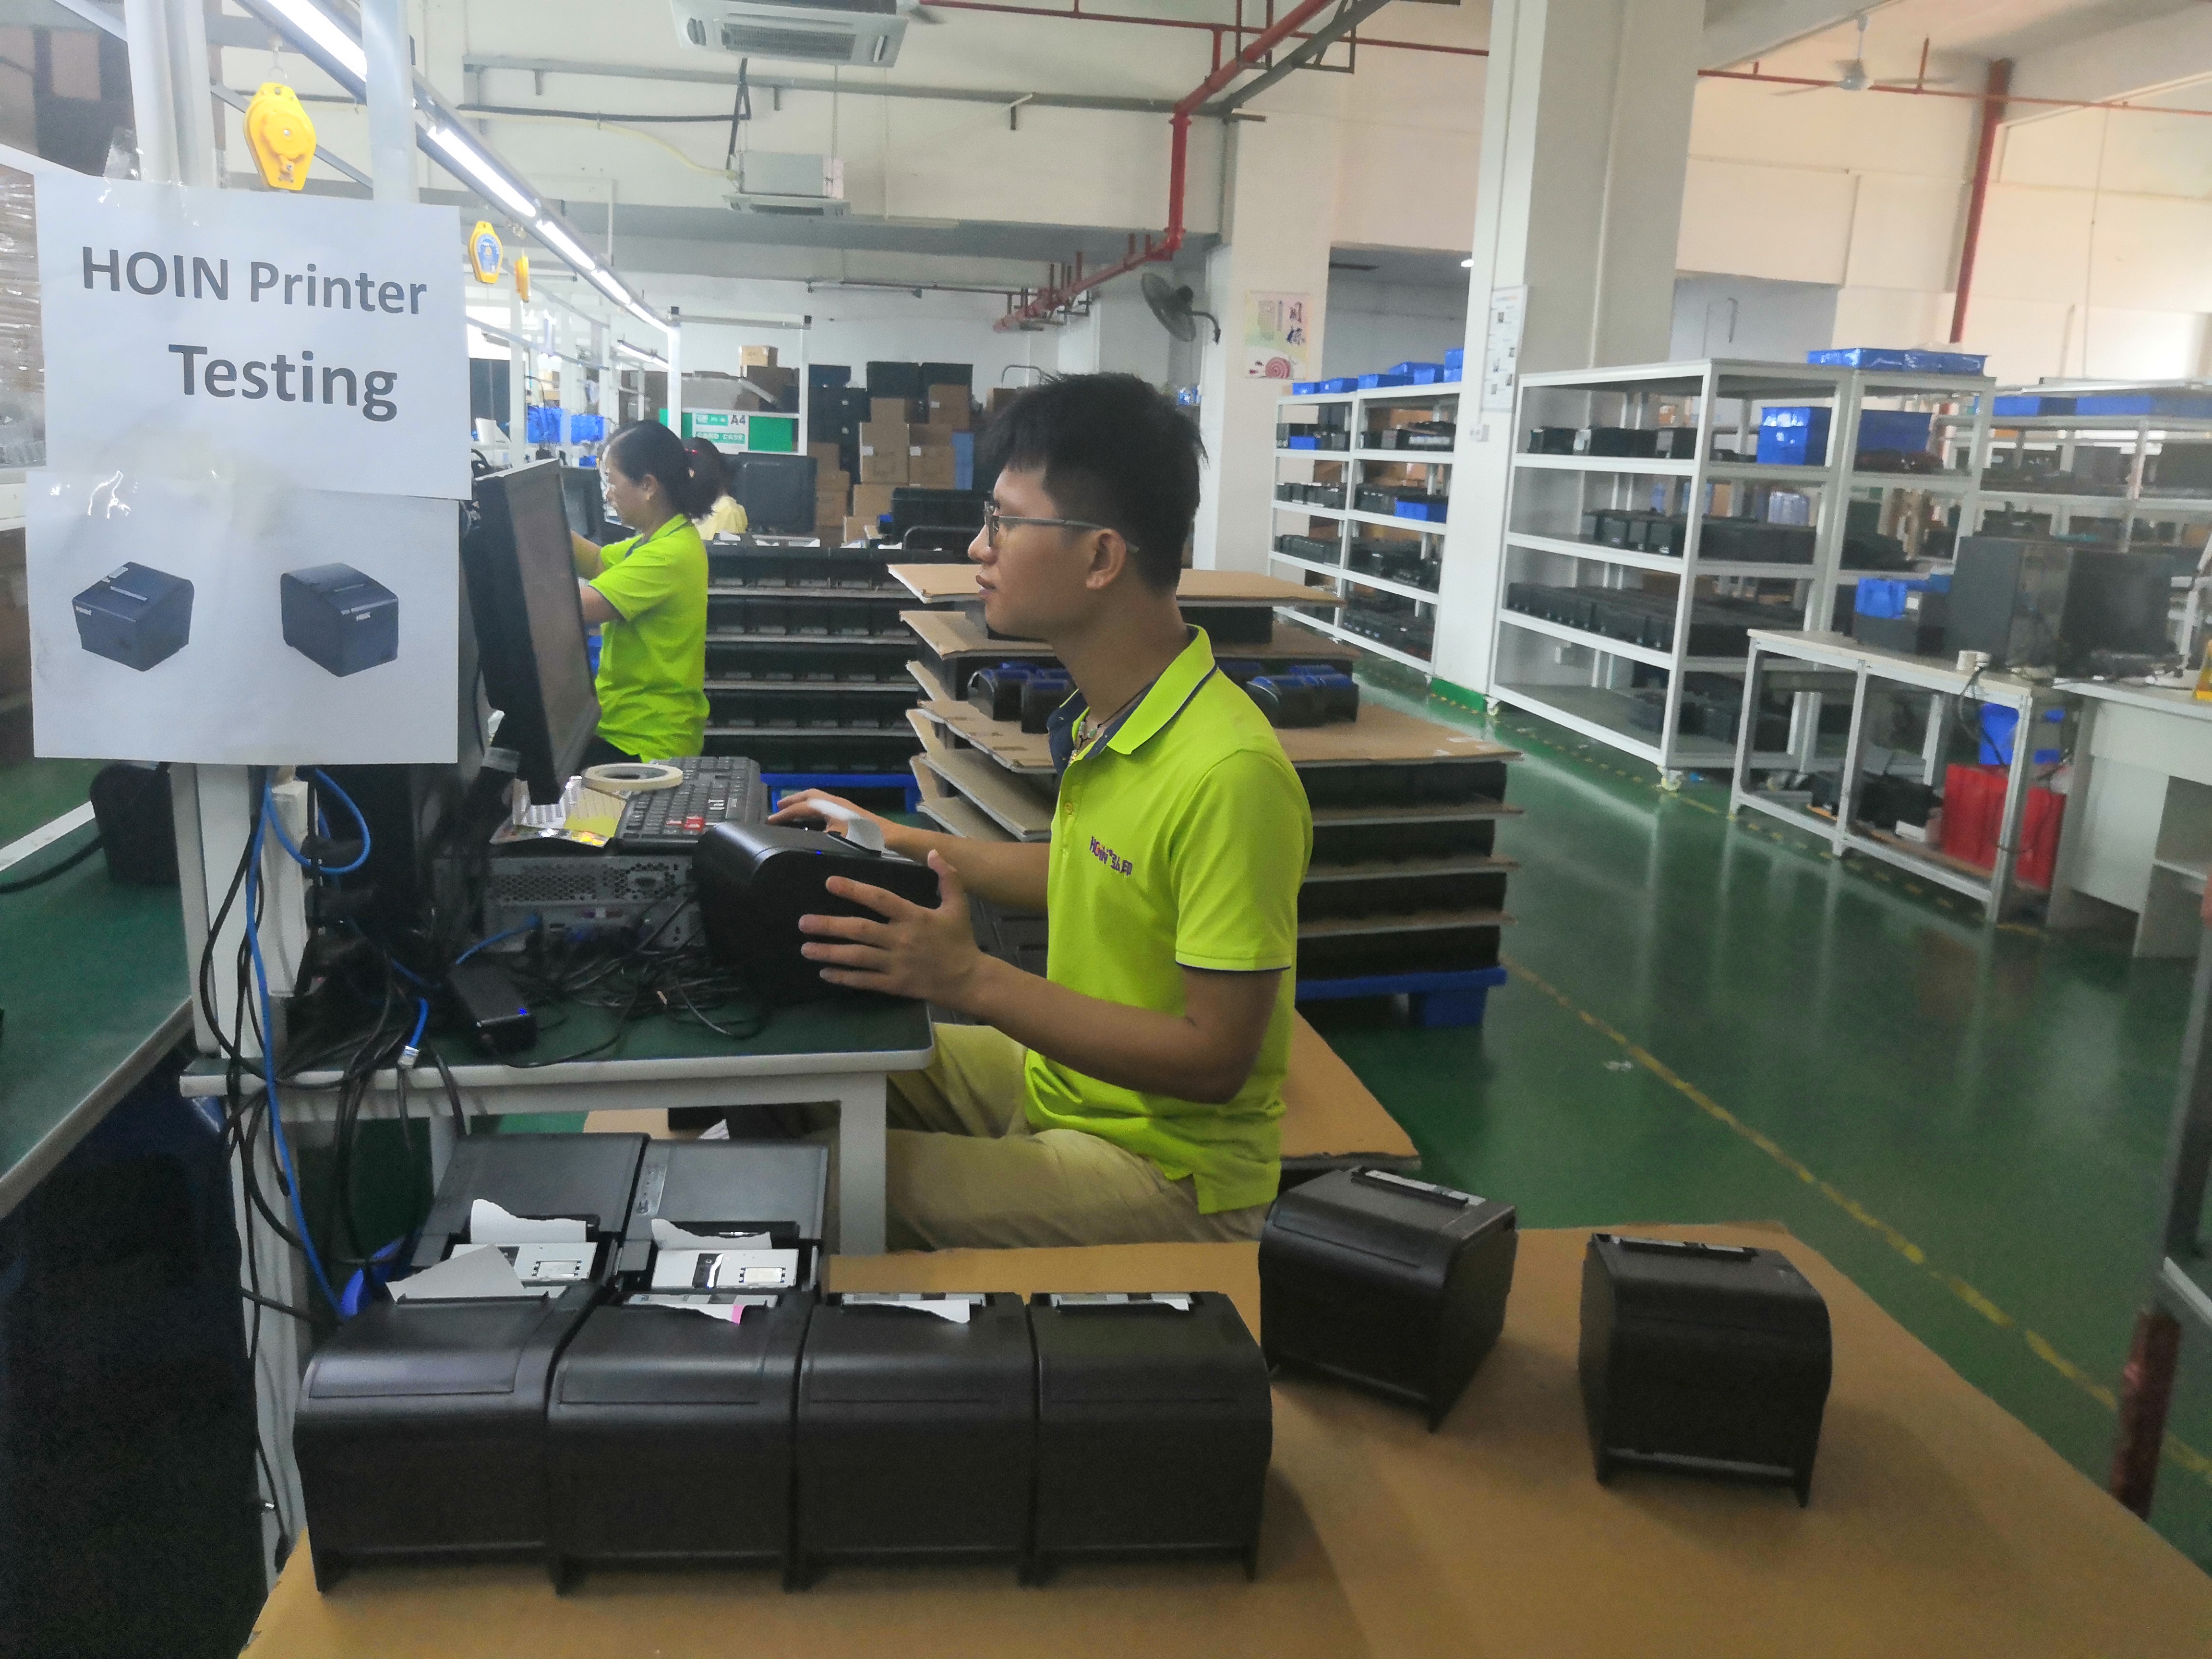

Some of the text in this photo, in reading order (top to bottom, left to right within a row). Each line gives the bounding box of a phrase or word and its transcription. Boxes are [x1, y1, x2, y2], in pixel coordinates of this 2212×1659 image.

[83, 246, 427, 315] HOIN Printer
[168, 343, 398, 422] Testing
[730, 414, 745, 425] A4
